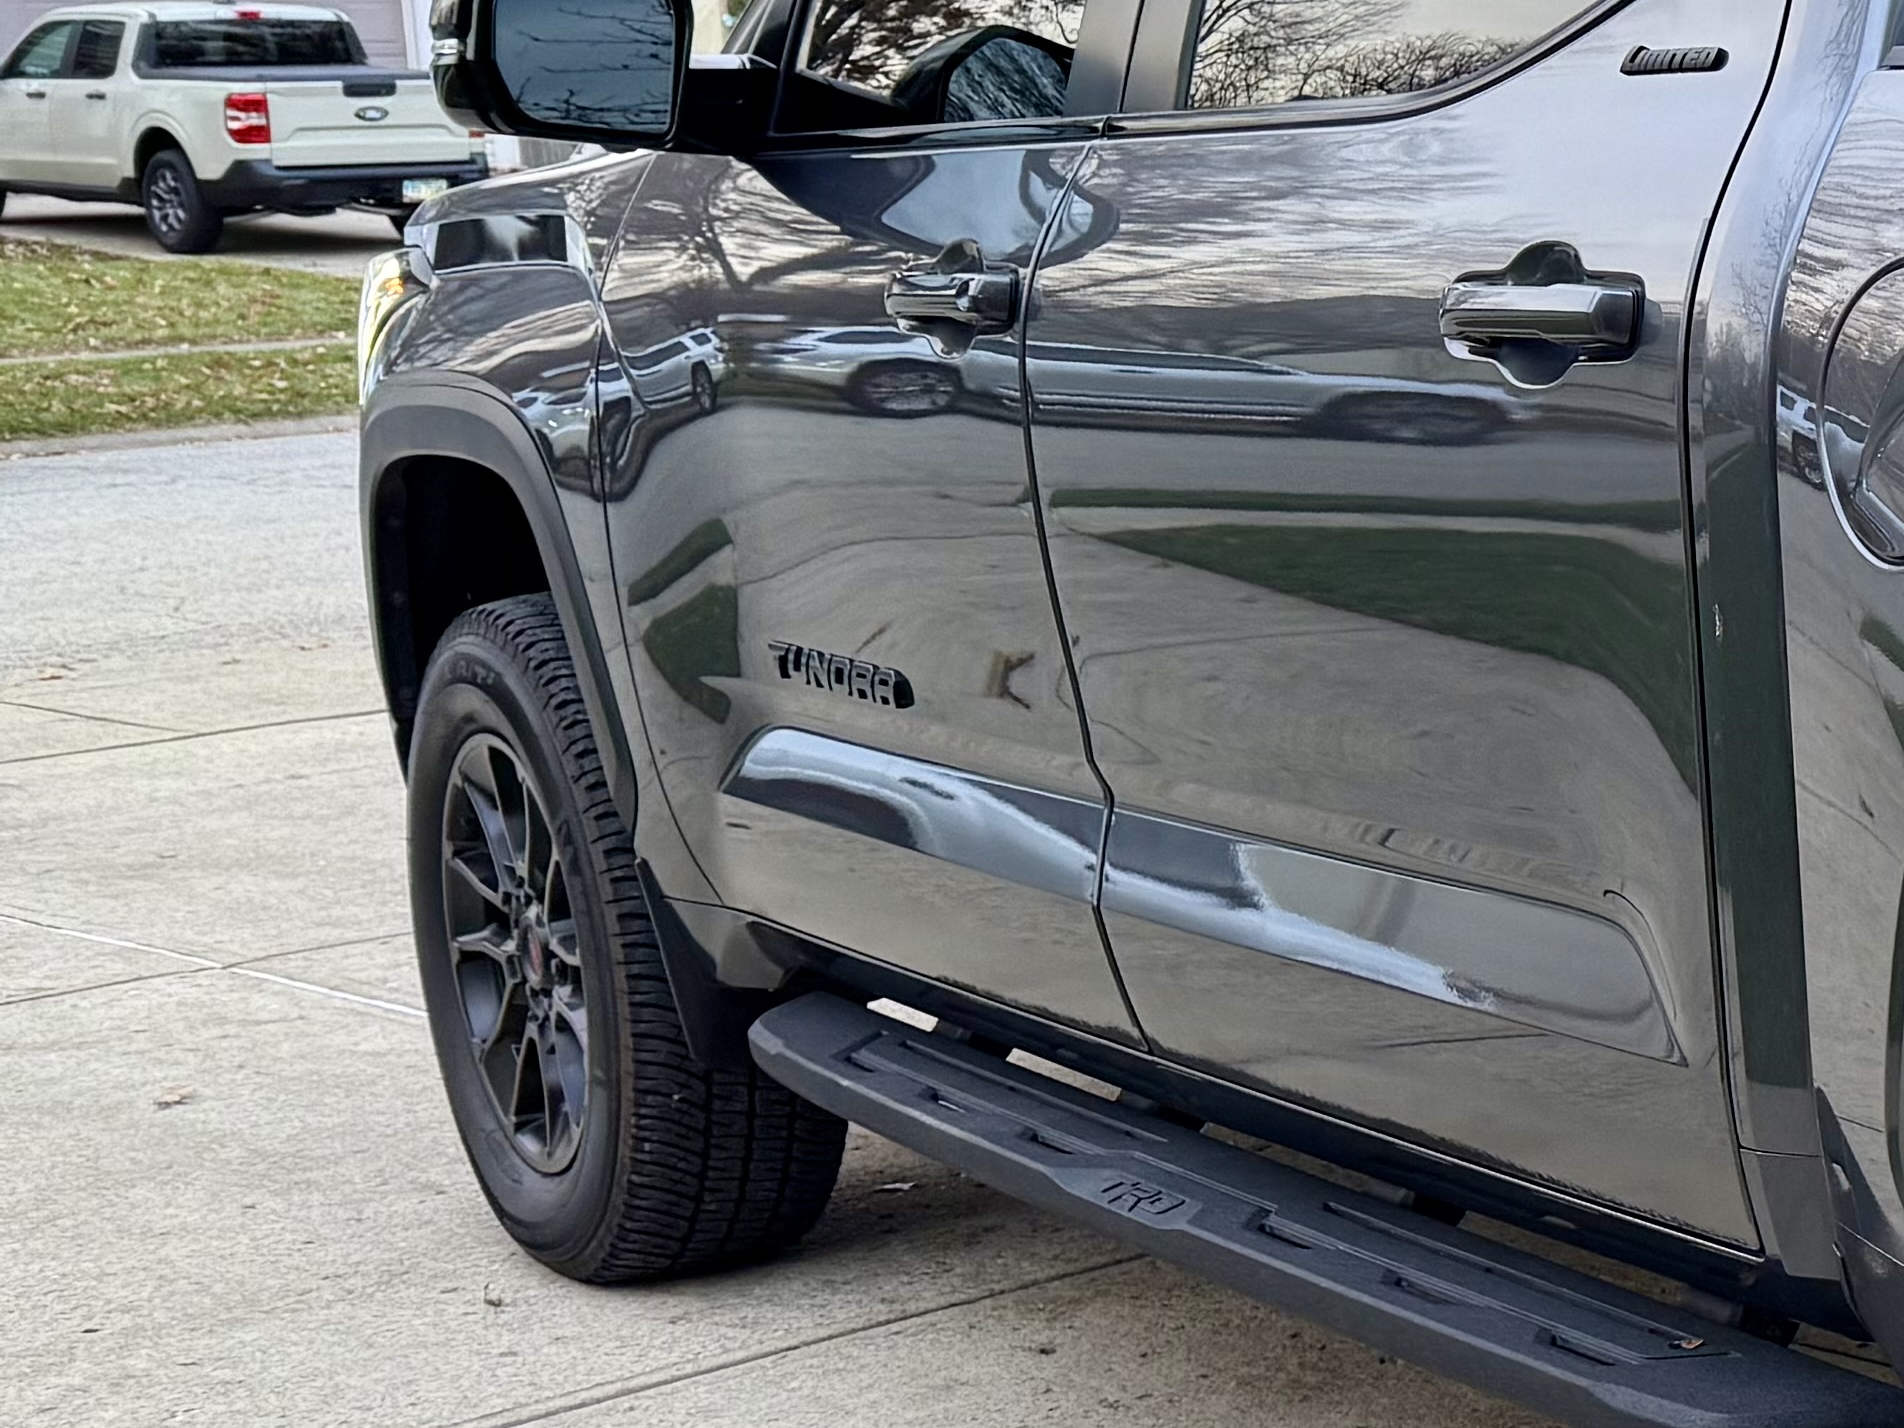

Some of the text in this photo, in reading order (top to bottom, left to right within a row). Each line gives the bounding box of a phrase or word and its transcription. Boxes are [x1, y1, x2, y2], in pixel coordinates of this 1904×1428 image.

[1620, 45, 1730, 76] LIMITED
[768, 639, 914, 708] TUNDRA
[1100, 1181, 1187, 1215] TRD
